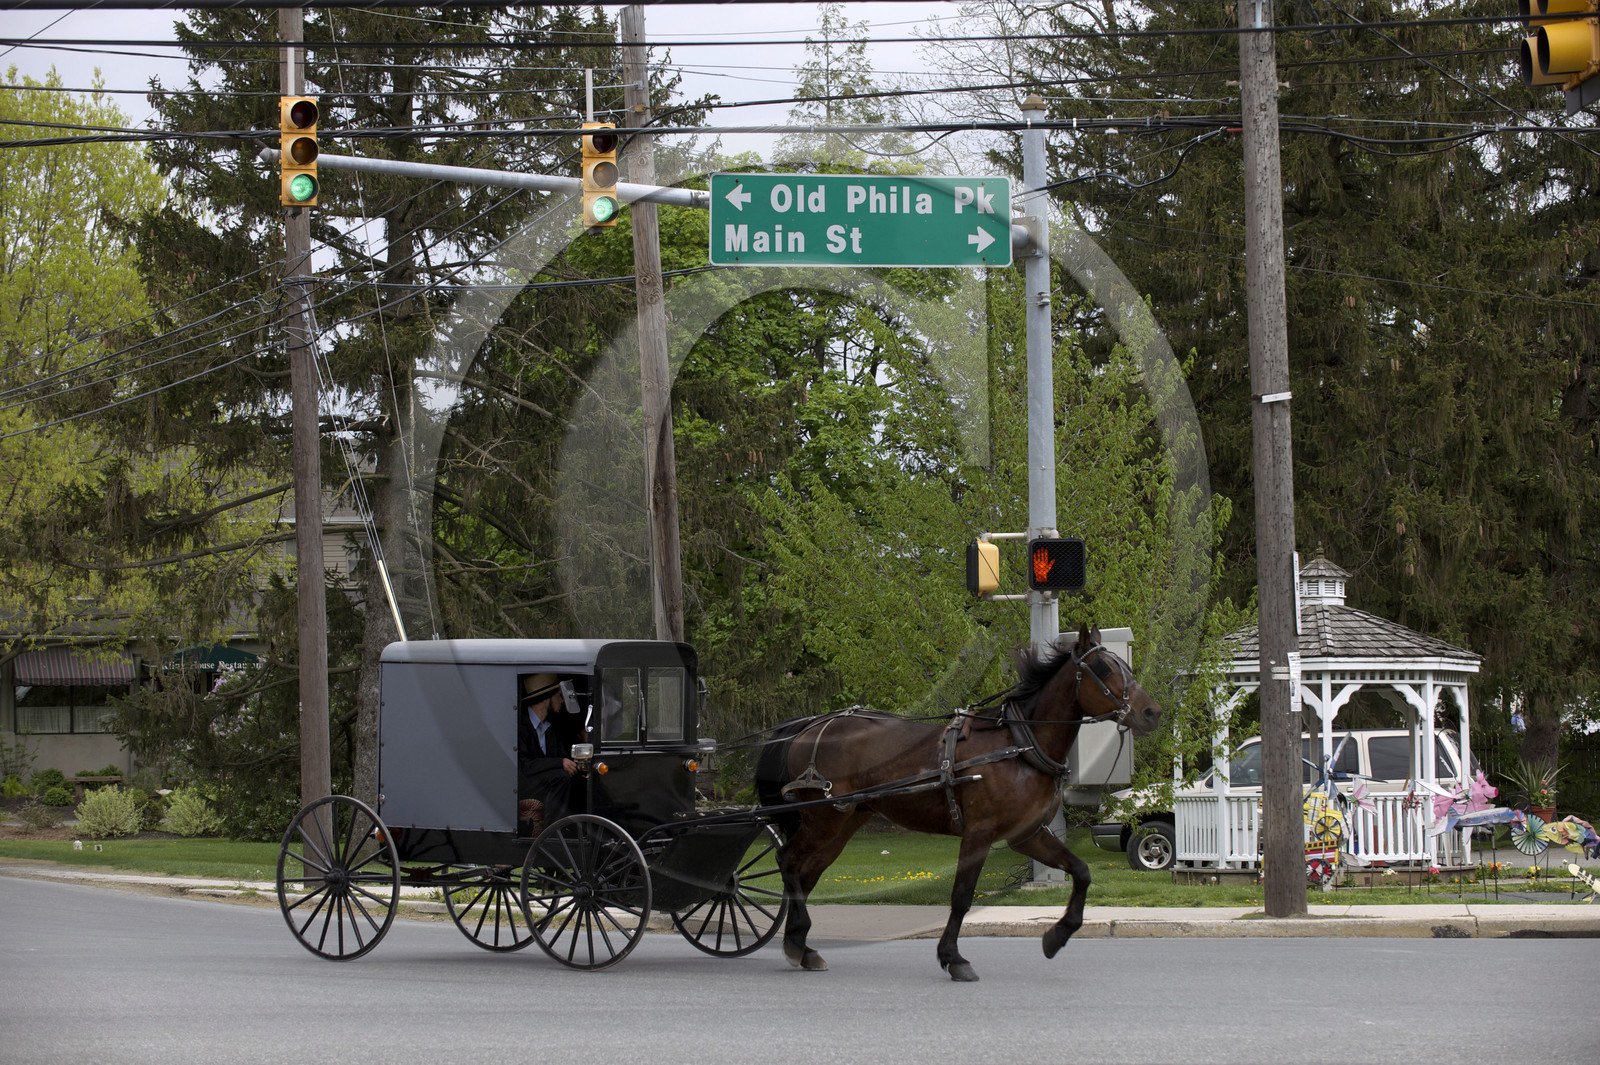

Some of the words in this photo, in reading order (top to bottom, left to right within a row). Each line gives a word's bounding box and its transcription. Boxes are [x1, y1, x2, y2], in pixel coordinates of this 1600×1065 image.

[770, 183, 826, 213] Old
[847, 184, 933, 214] Phila
[954, 186, 995, 214] Pk
[725, 224, 805, 252] Main
[826, 224, 862, 253] St
